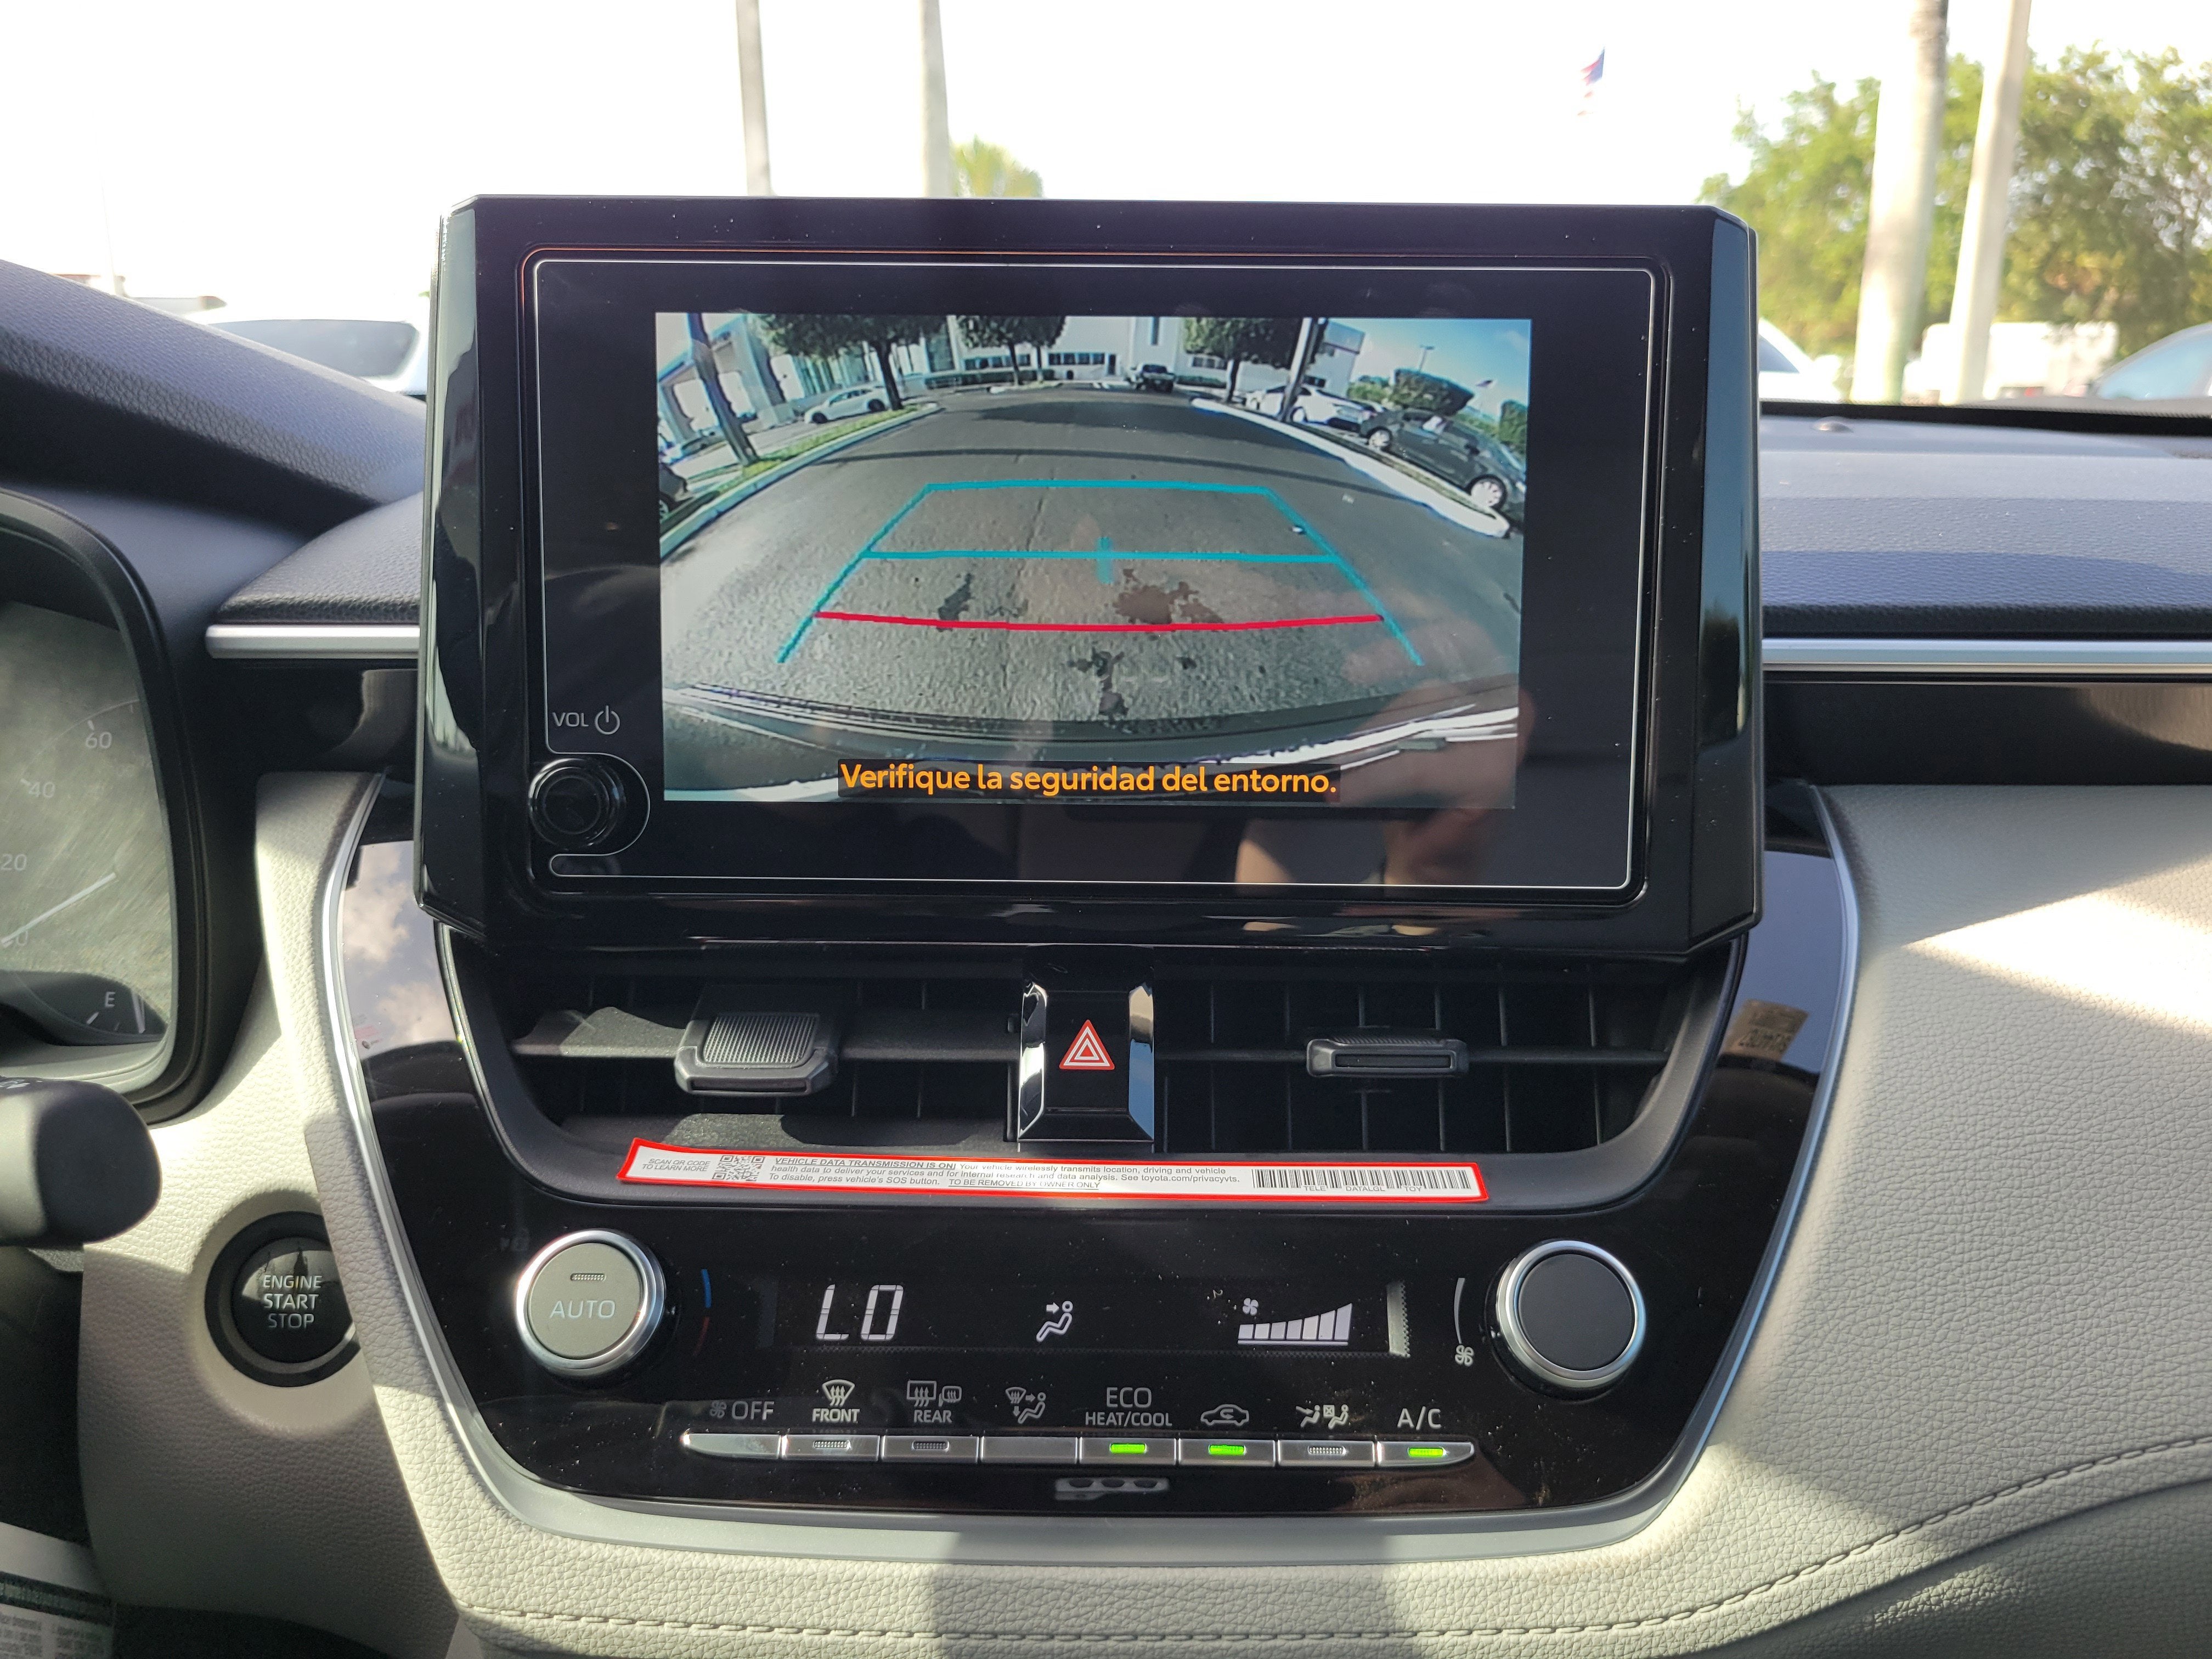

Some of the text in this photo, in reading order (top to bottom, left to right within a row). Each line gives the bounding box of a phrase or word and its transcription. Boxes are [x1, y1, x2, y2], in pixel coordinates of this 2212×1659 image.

[552, 712, 589, 727] VOL
[86, 732, 112, 749] 60
[840, 764, 1336, 797] Verifique la seguridad del entorno.
[27, 782, 55, 798] 40
[1, 854, 27, 871] 20
[104, 991, 116, 1008] E
[849, 1160, 924, 1168] TRANSMISSION
[1015, 1165, 1058, 1173] wirelessly
[782, 1173, 815, 1182] disable,
[1142, 1174, 1240, 1183] toyota.com/privacyvts.
[263, 1274, 323, 1289] ENGINE
[263, 1293, 319, 1310] START
[550, 1300, 616, 1318] AUTO
[268, 1313, 314, 1329] STOP
[1106, 1387, 1152, 1407] ECO
[731, 1401, 774, 1420] OFF
[812, 1408, 860, 1423] FRONT
[913, 1409, 952, 1423] REAR
[1397, 1407, 1442, 1431] A/C
[1085, 1411, 1172, 1428] HEAT/COOL
